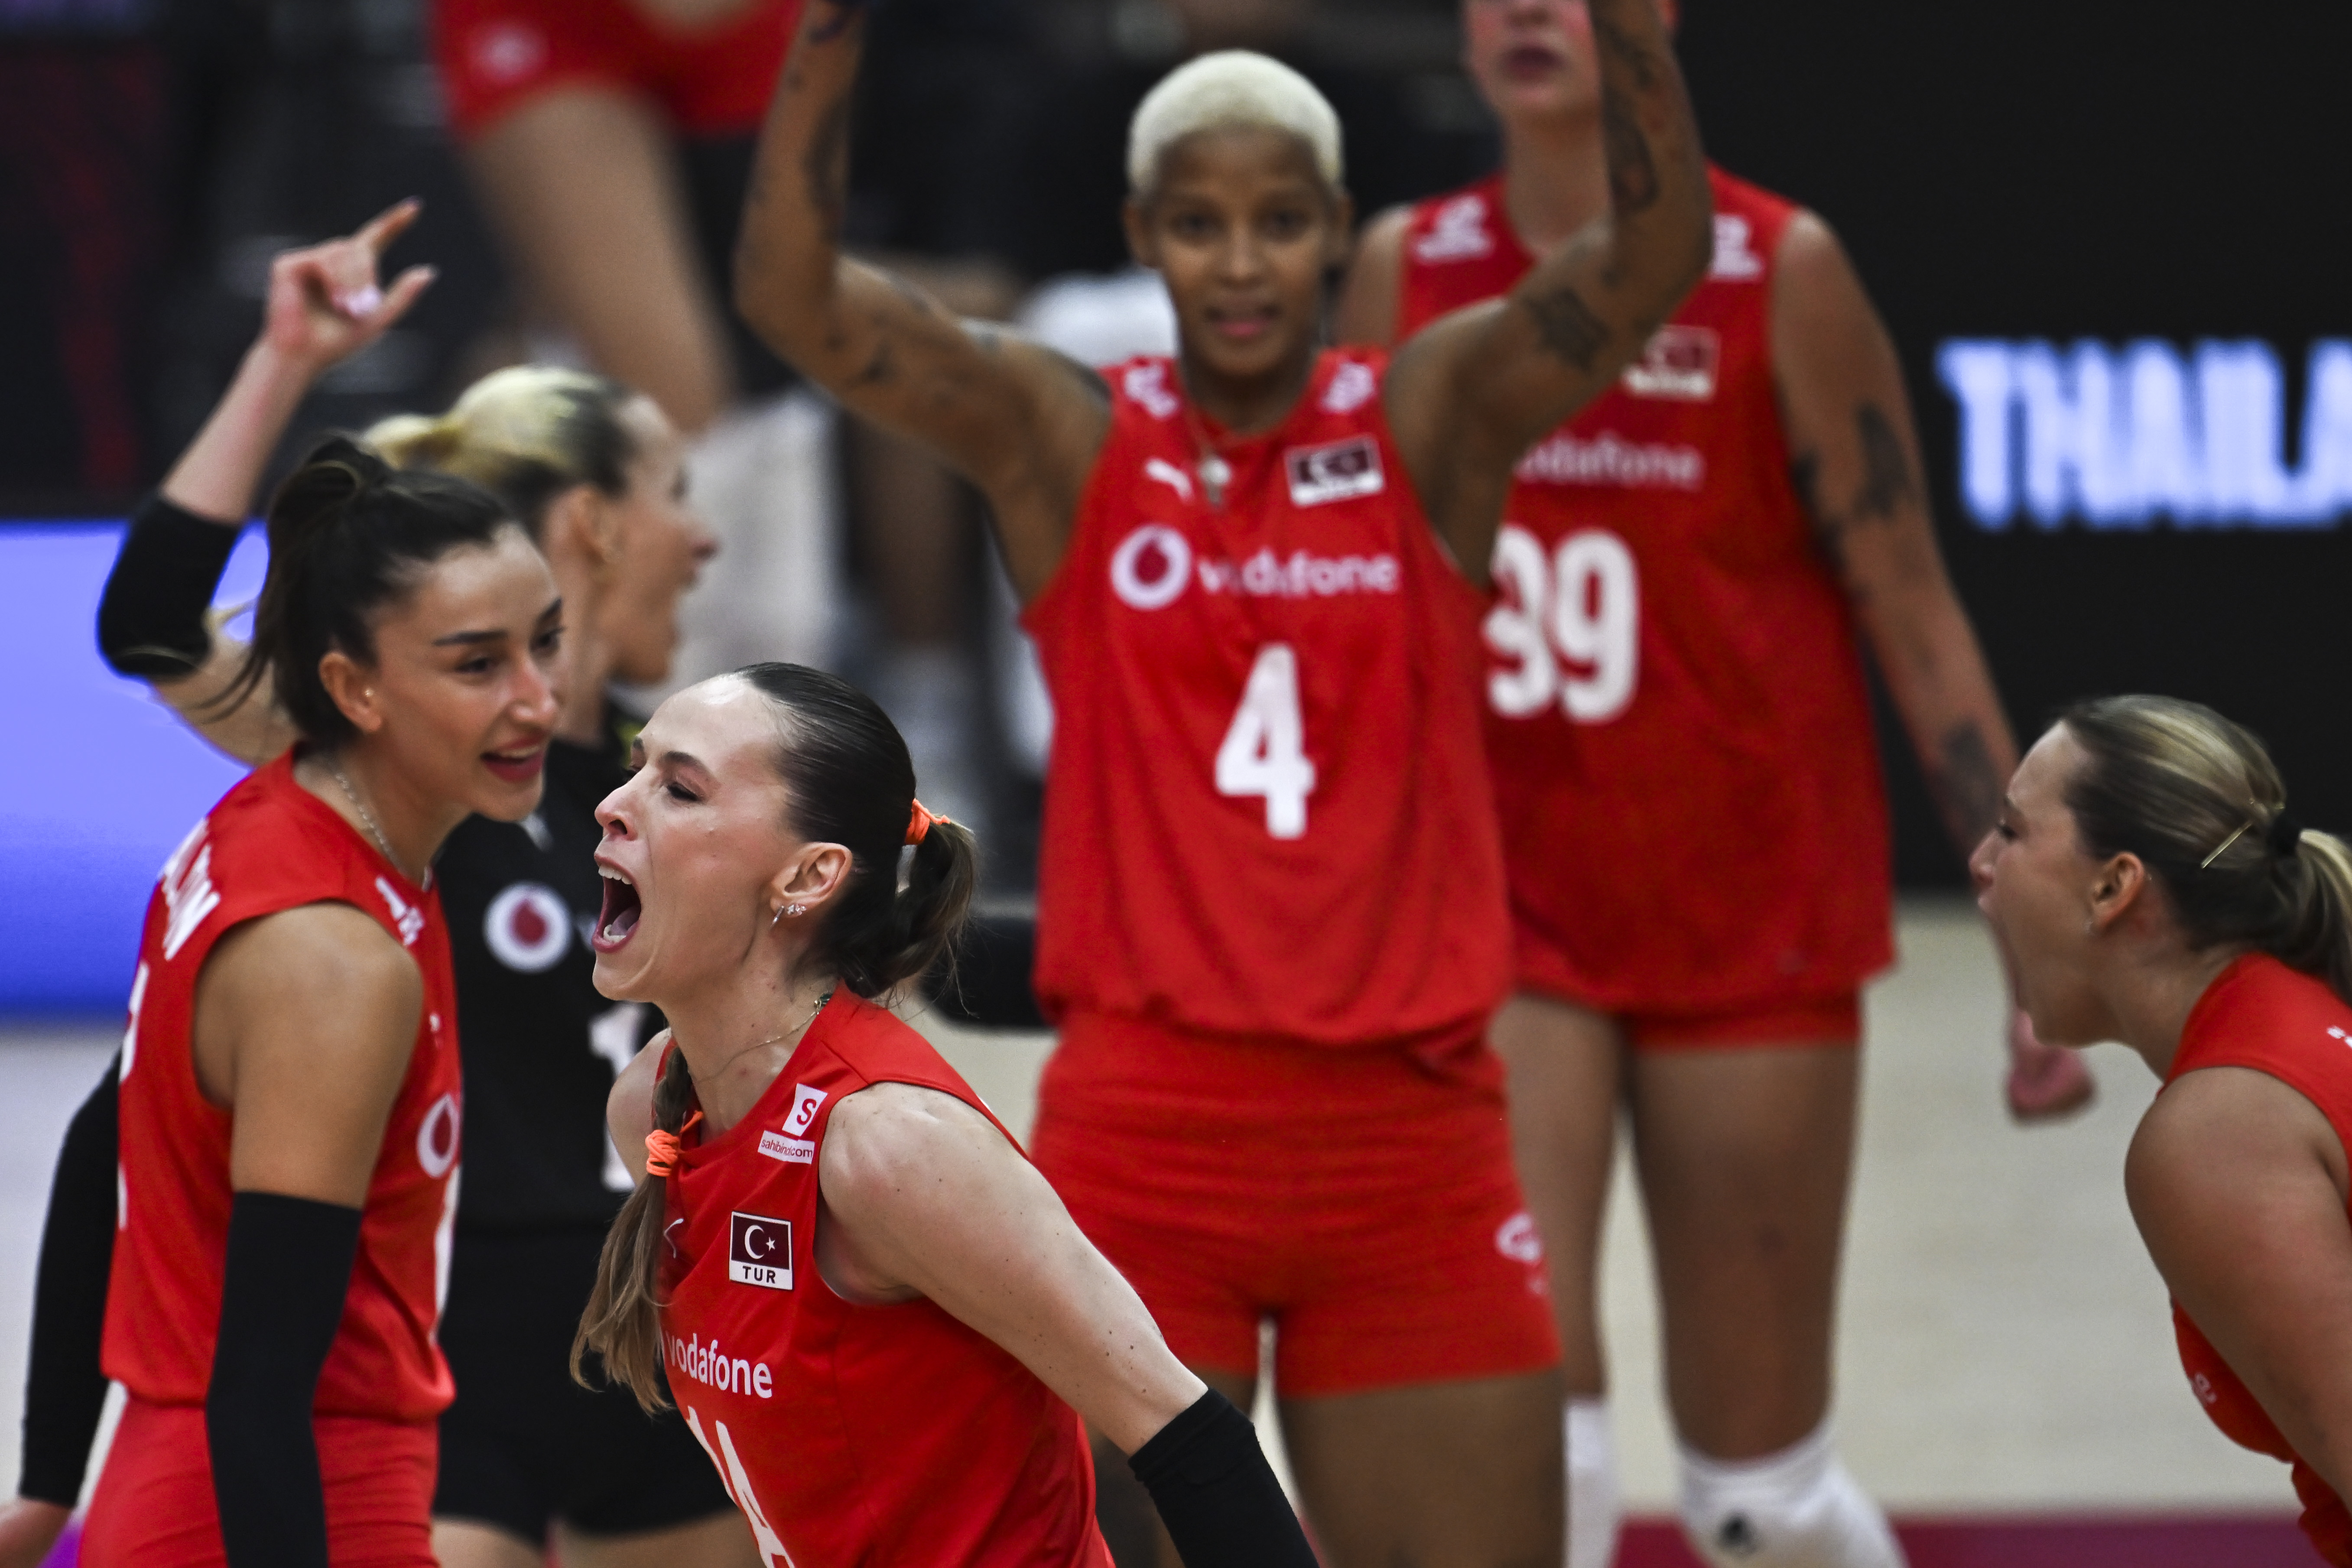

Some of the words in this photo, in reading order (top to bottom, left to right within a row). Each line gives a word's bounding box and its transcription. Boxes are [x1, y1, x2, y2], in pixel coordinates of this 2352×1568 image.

[1481, 527, 1641, 722] 39
[1215, 642, 1317, 839] 4
[796, 1098, 817, 1126] S
[742, 1265, 776, 1284] TUR
[665, 1333, 772, 1399] vodafone
